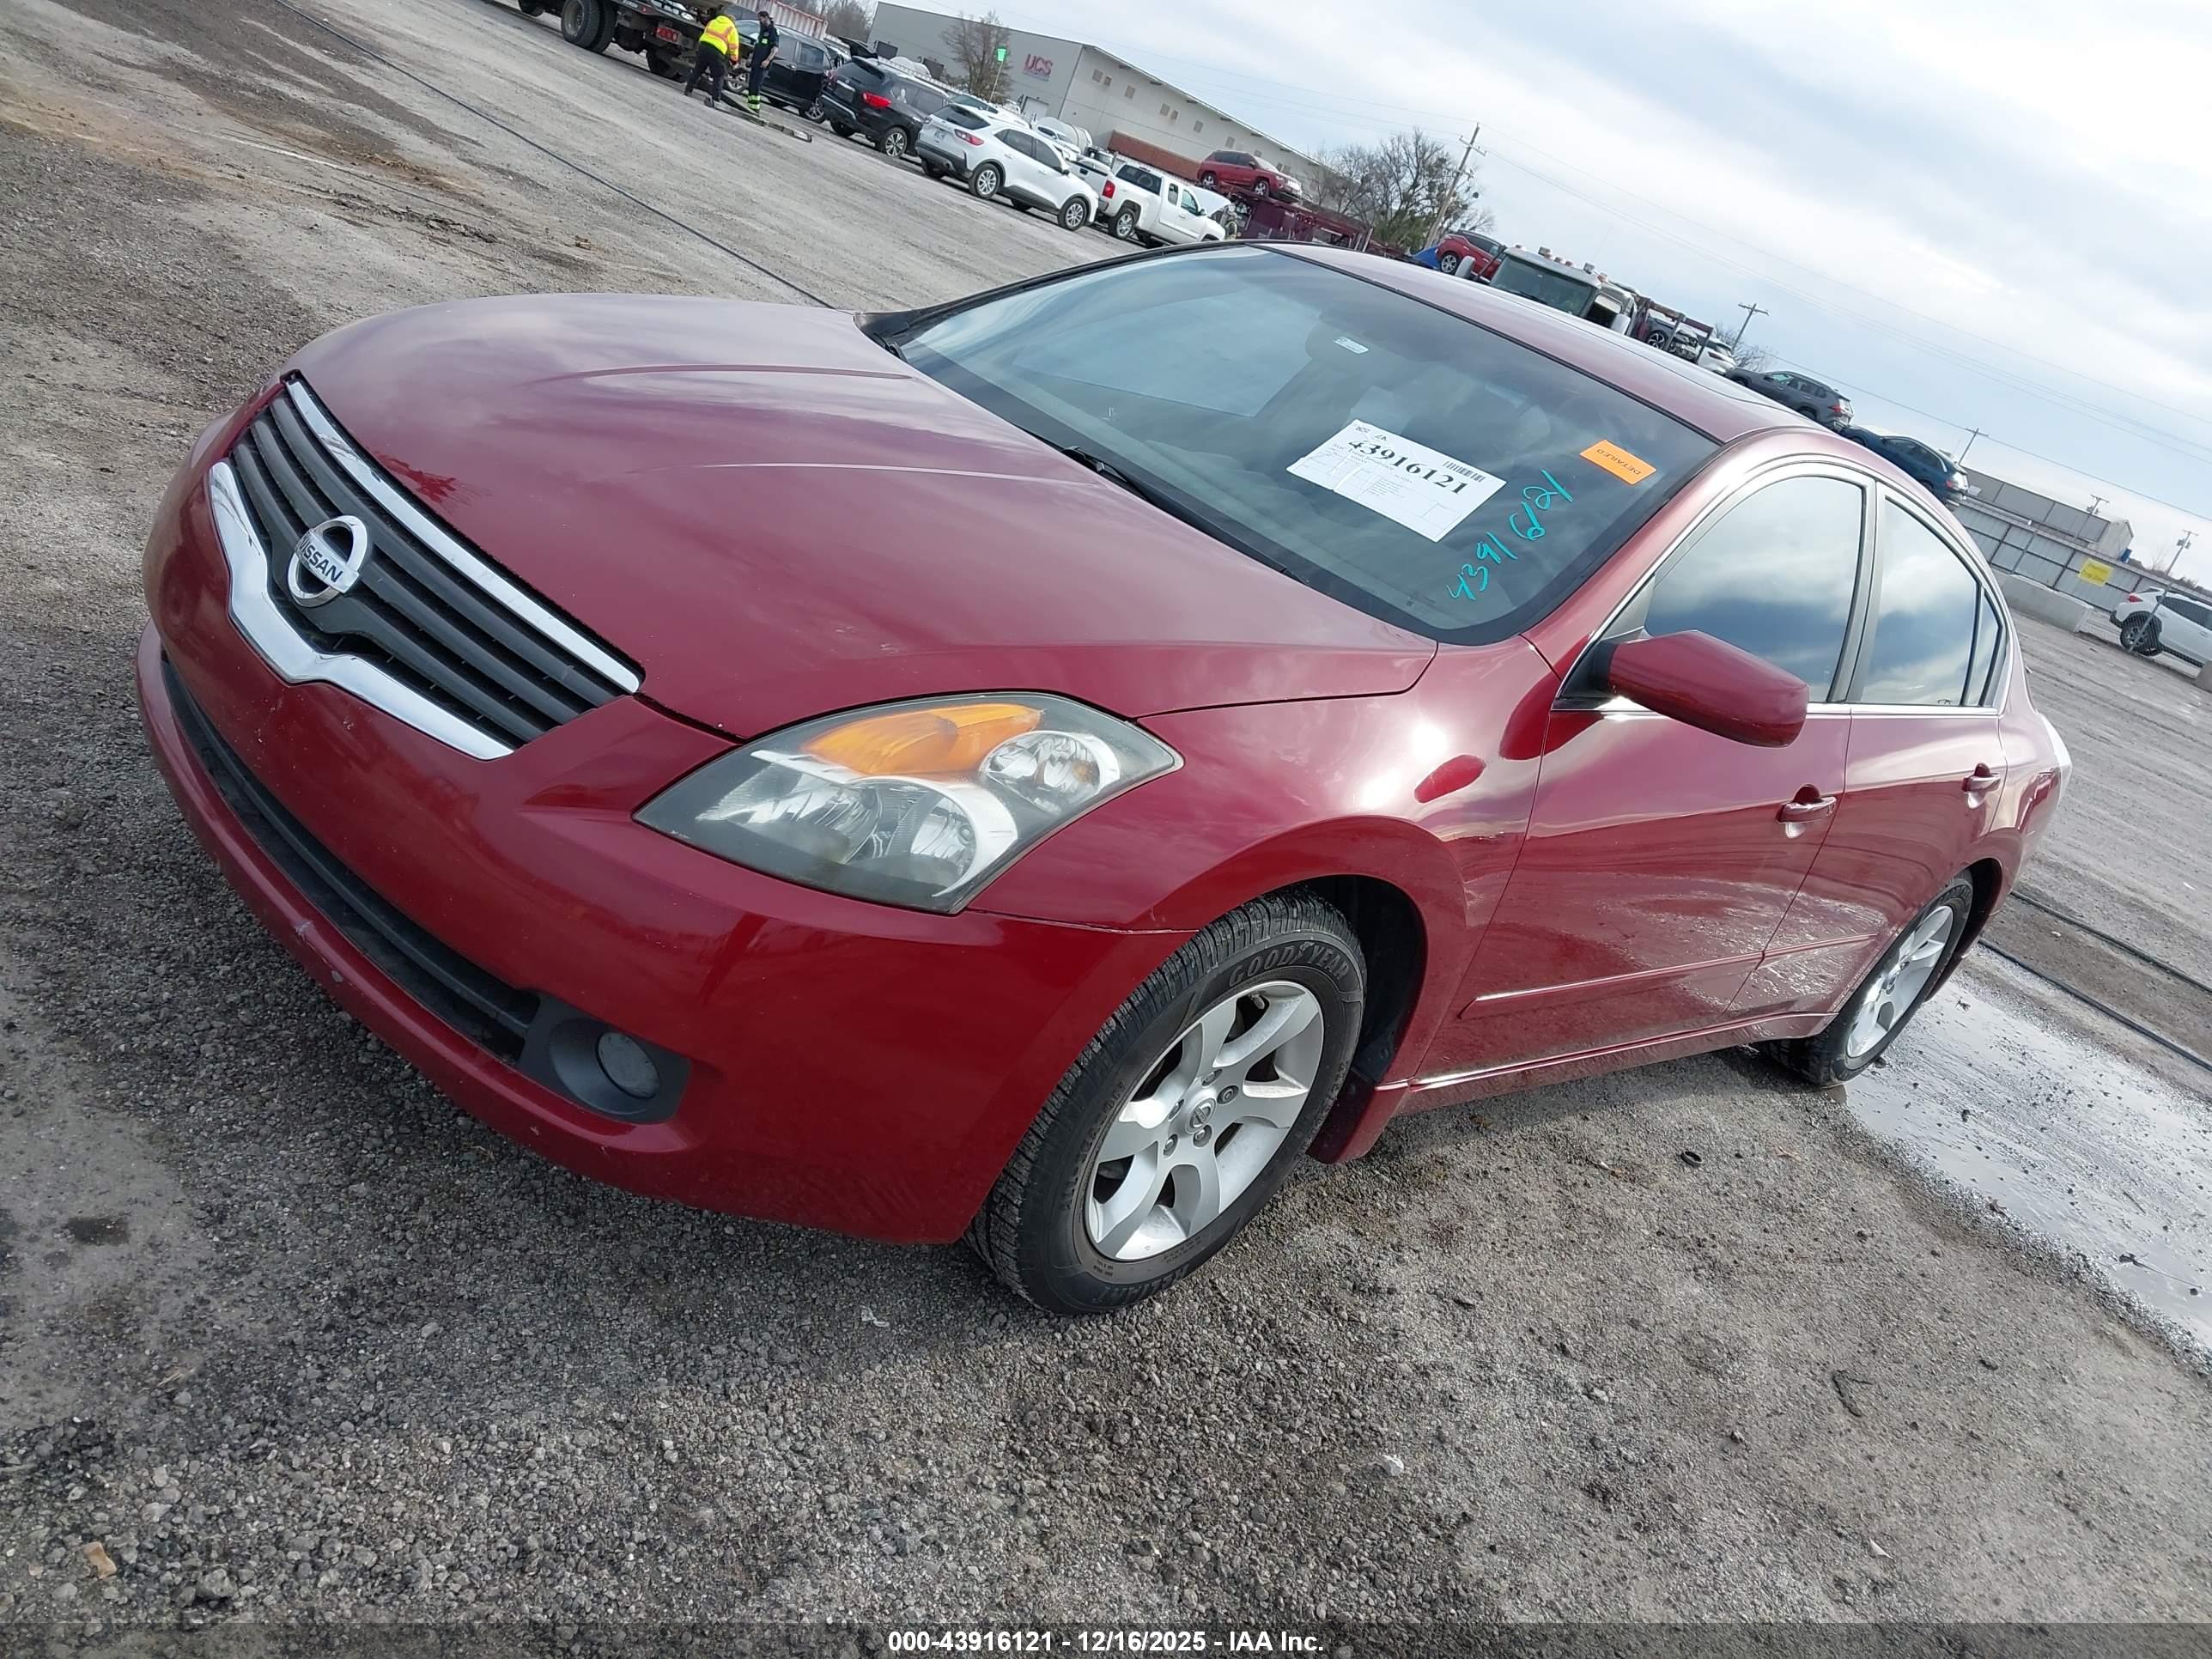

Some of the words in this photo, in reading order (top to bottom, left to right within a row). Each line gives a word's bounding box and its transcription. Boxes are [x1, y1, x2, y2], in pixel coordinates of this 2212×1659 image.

[1024, 52, 1054, 76] UCS
[1348, 440, 1469, 495] 43916121
[1595, 448, 1642, 475] DETAILED
[298, 536, 343, 583] NISSAN
